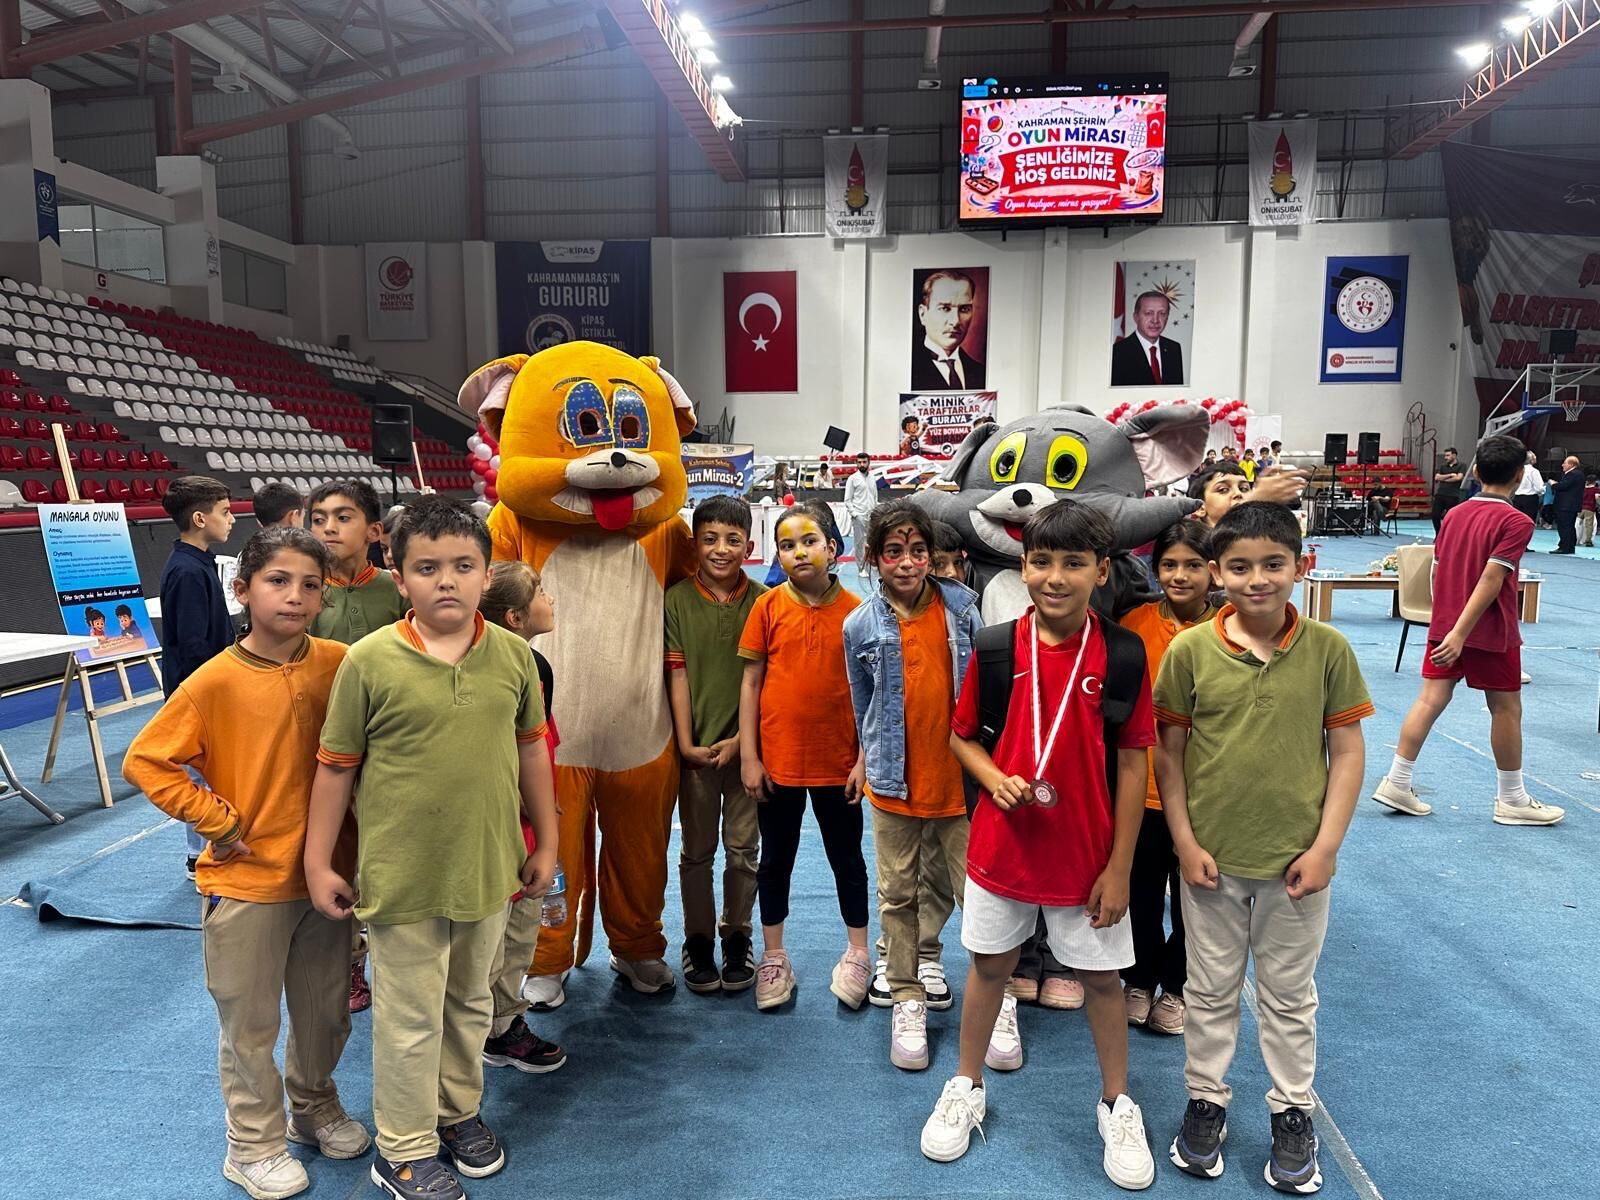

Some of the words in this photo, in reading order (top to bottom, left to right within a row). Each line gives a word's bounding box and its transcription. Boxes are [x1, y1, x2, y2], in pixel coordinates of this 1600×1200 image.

[1018, 118, 1071, 128] KAHRAMAN
[1073, 116, 1106, 126] ŞEHRİN
[1008, 128, 1060, 147] OYUN
[1016, 147, 1114, 168] ŞENLİĞİMİZE
[1014, 168, 1047, 184] HOŞ
[1050, 164, 1117, 182] GELDİNİZ
[1005, 199, 1025, 211] Oyun
[1058, 199, 1078, 207] miras
[1080, 195, 1113, 210] yaşıyor!
[98, 272, 106, 287] G
[528, 272, 620, 285] KAHRAMANMARAŞ'IN
[539, 286, 610, 306] GURURU
[918, 405, 980, 416] TARAFTARLAR
[932, 415, 966, 424] BURAYA
[688, 472, 702, 484] un
[50, 512, 90, 522] MANGALA
[93, 512, 119, 522] OYUNU
